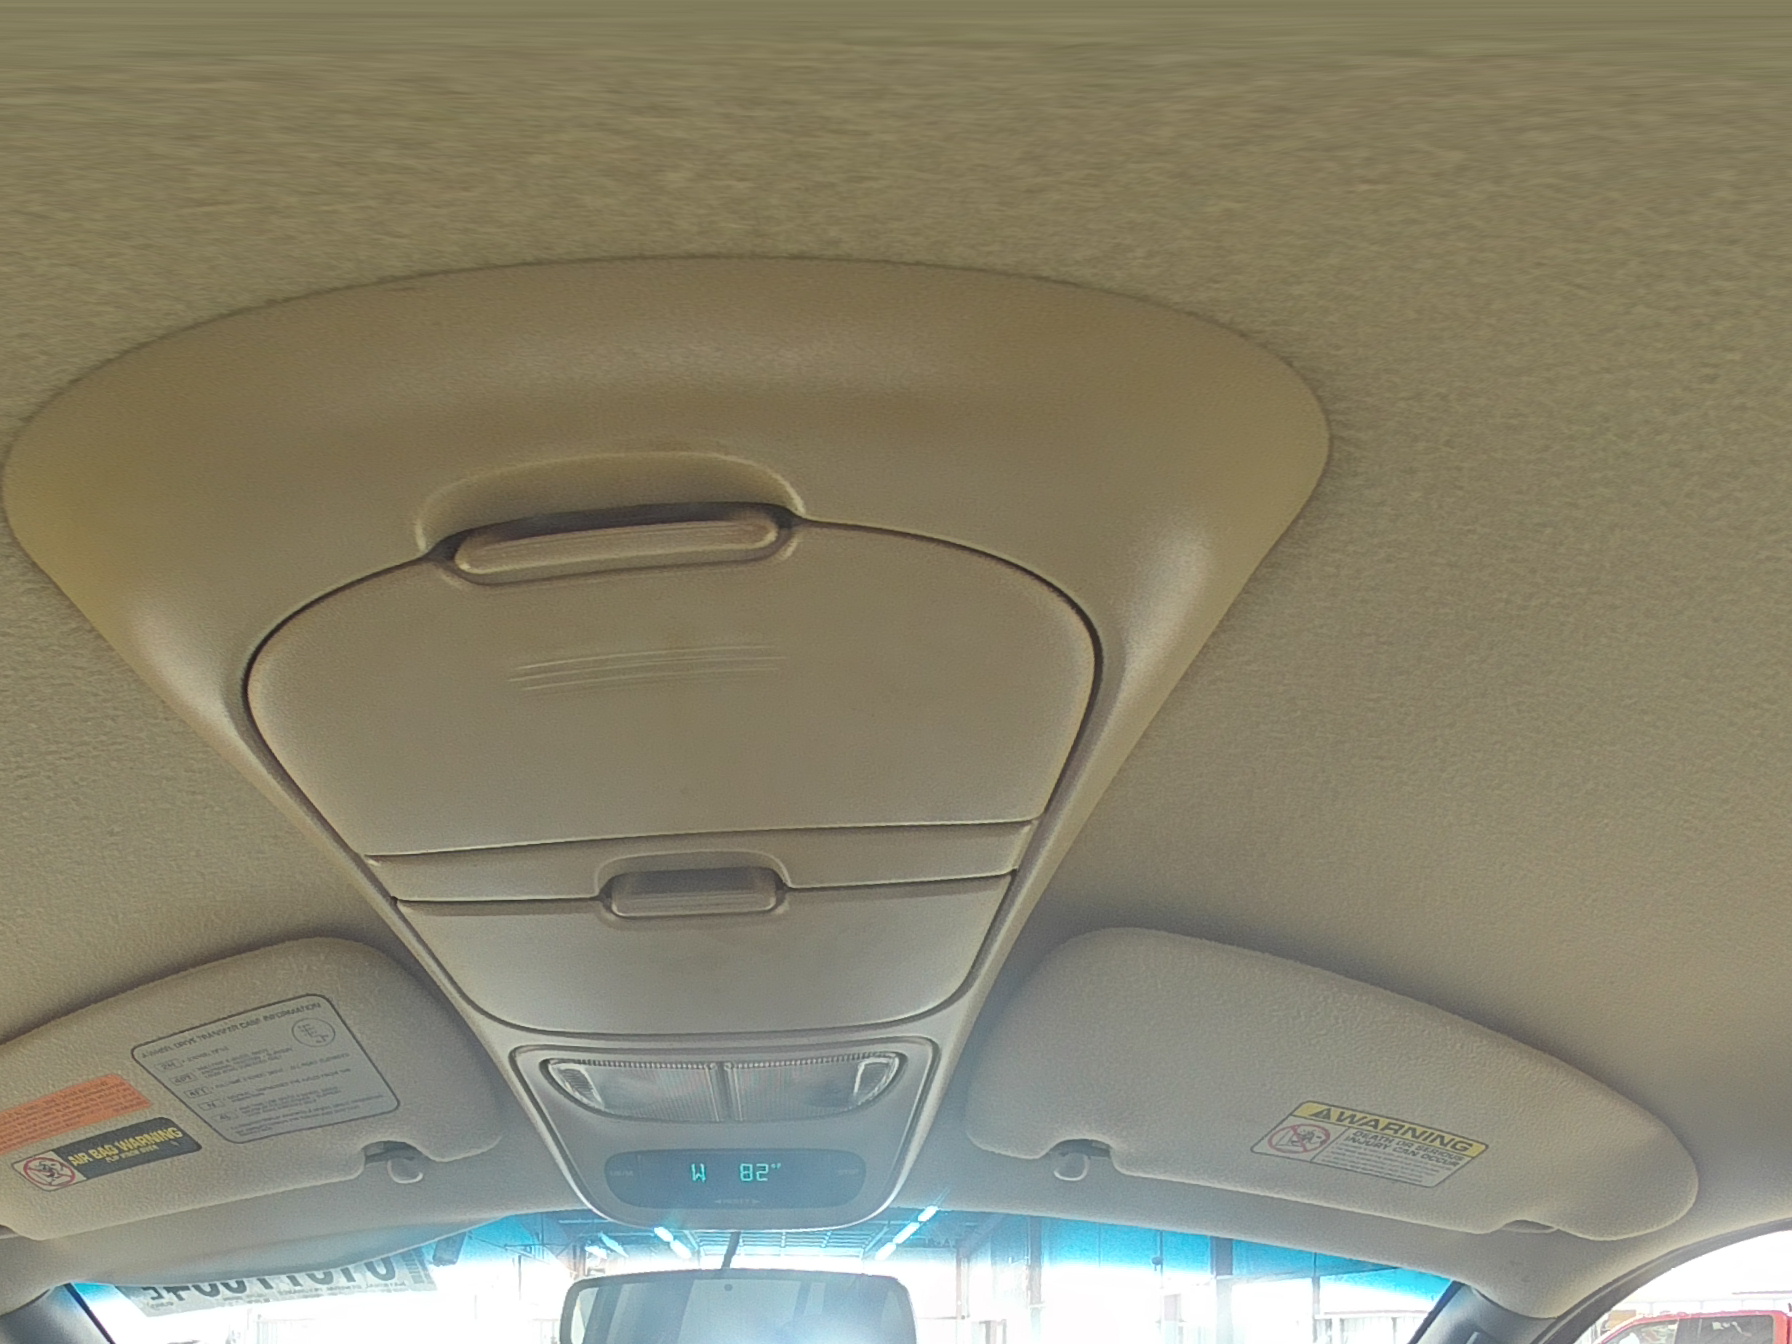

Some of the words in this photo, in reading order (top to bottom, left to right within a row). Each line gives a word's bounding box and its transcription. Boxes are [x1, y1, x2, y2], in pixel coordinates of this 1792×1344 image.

[173, 1036, 197, 1049] DRIVE
[198, 1024, 240, 1043] TRANSFER
[263, 1002, 322, 1022] INFORMATION
[67, 1152, 94, 1167] AIR
[88, 1144, 119, 1160] BAG
[115, 1126, 183, 1152] WARNING
[1335, 1110, 1474, 1152] WARNING
[1352, 1130, 1395, 1144] DEATH
[1395, 1138, 1415, 1150] OR
[1414, 1144, 1466, 1163] SERIOUS
[1343, 1135, 1389, 1151] INJURY
[1392, 1145, 1419, 1157] CAN
[1420, 1152, 1462, 1168] OCCUR
[691, 1163, 707, 1182] W
